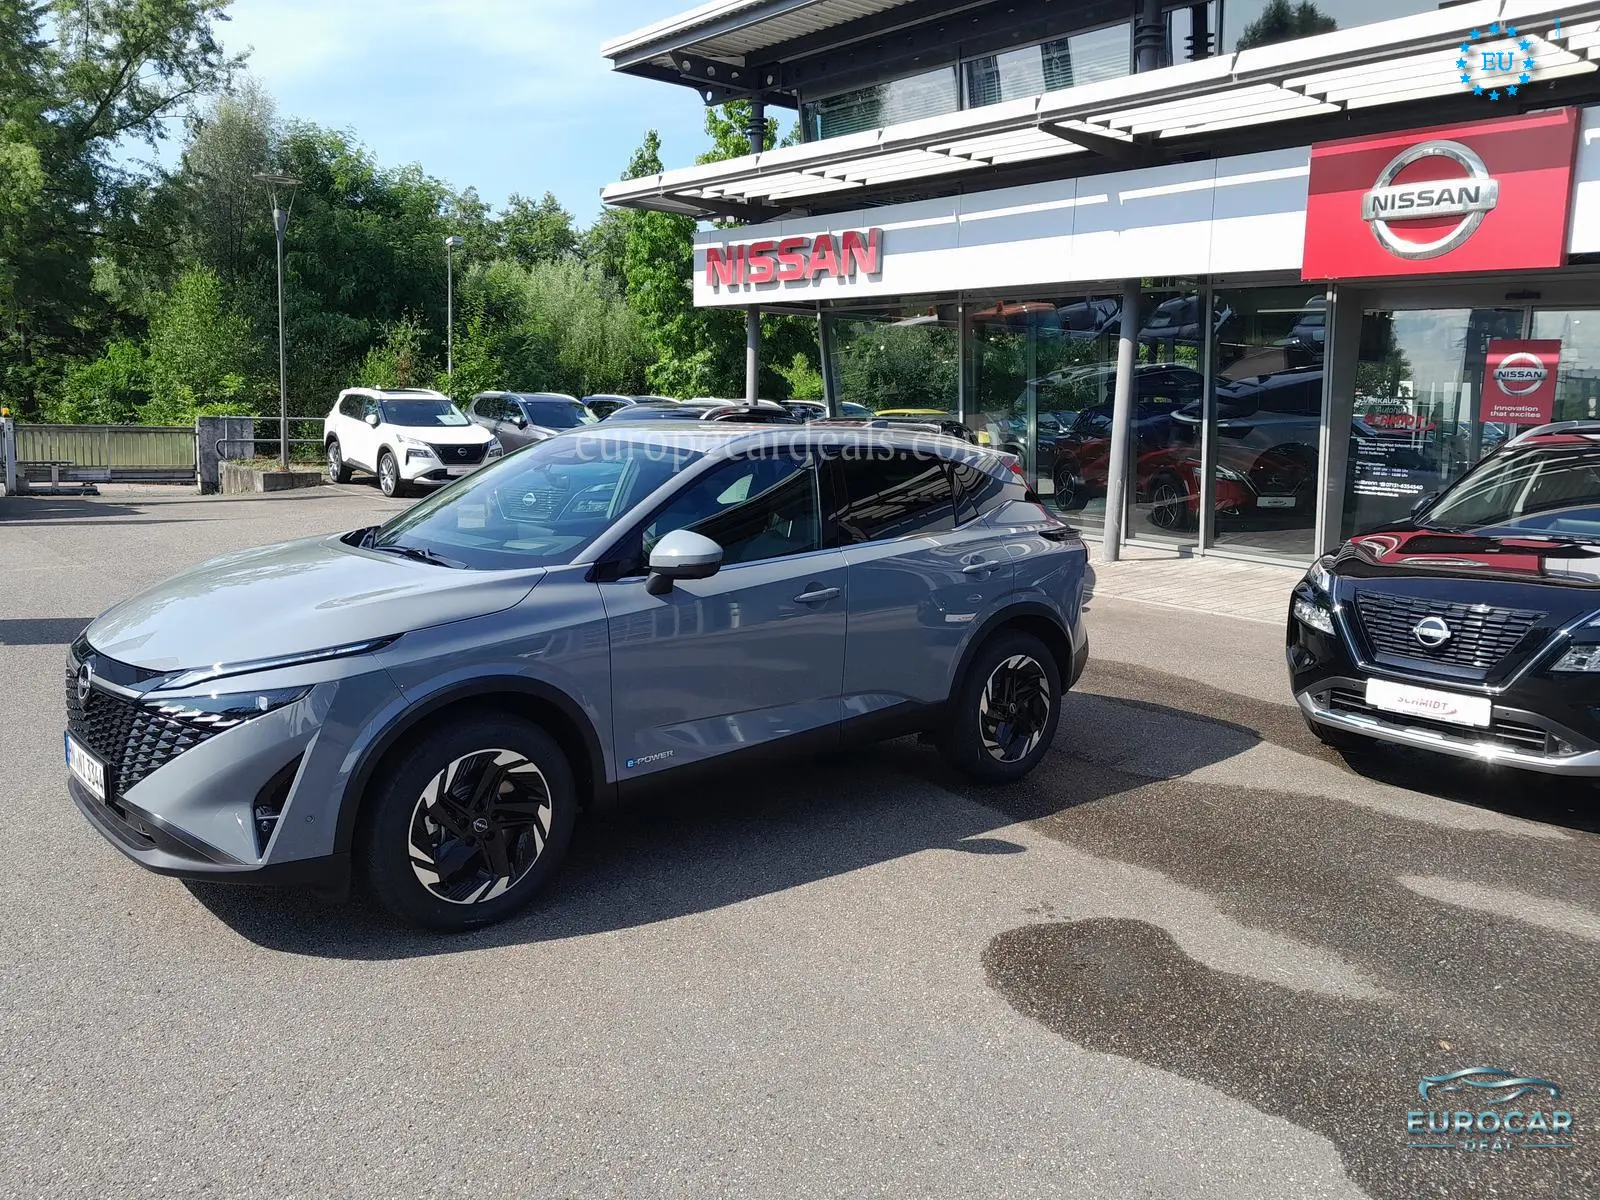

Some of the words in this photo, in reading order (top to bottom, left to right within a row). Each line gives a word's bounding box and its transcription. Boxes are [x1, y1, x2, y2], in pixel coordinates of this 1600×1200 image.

[1372, 186, 1482, 212] NISSAN
[706, 228, 880, 287] NISSAN
[1498, 370, 1542, 378] NISSAN
[628, 750, 674, 768] e-POWER
